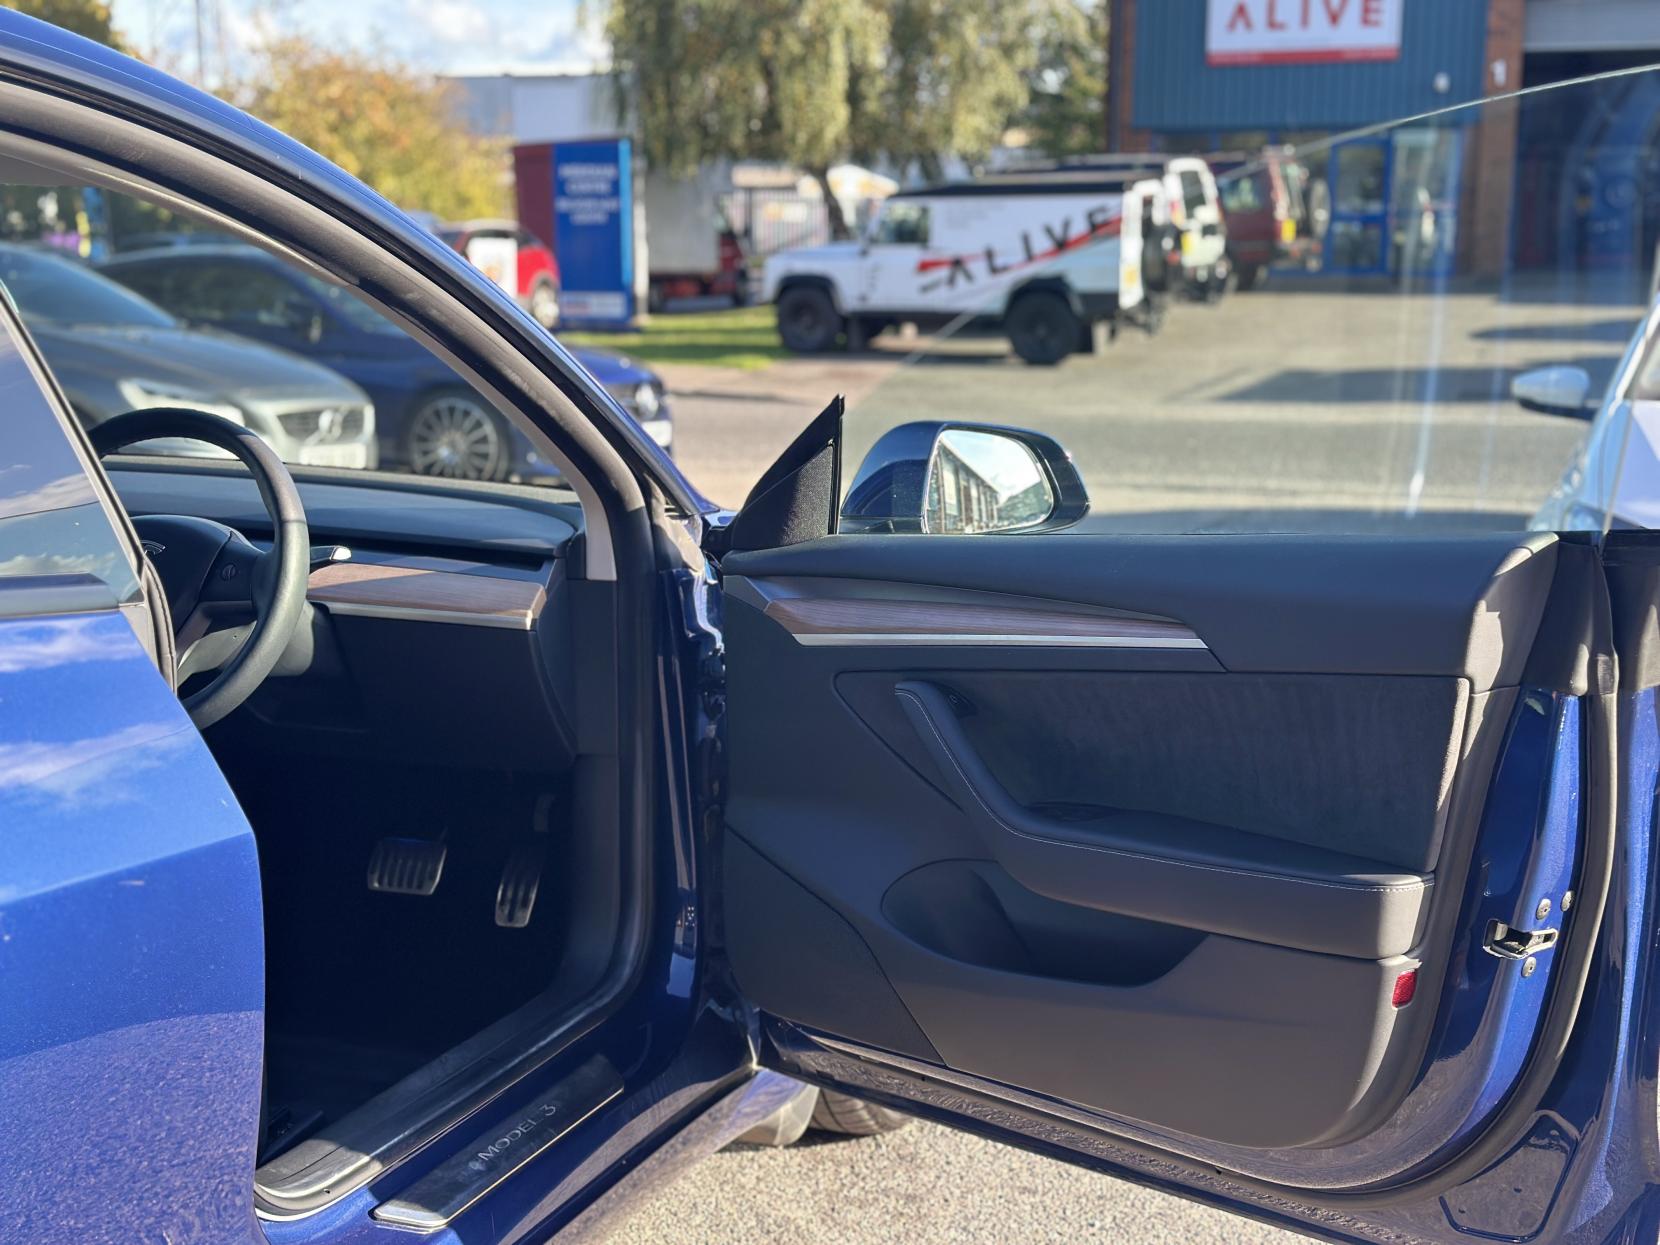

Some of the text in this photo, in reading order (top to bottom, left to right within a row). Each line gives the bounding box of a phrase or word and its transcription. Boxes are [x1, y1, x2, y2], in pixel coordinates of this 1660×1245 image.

[1226, 0, 1384, 32] ALIVE
[947, 205, 1110, 289] ALIVE
[477, 1104, 556, 1161] MODEL 3
